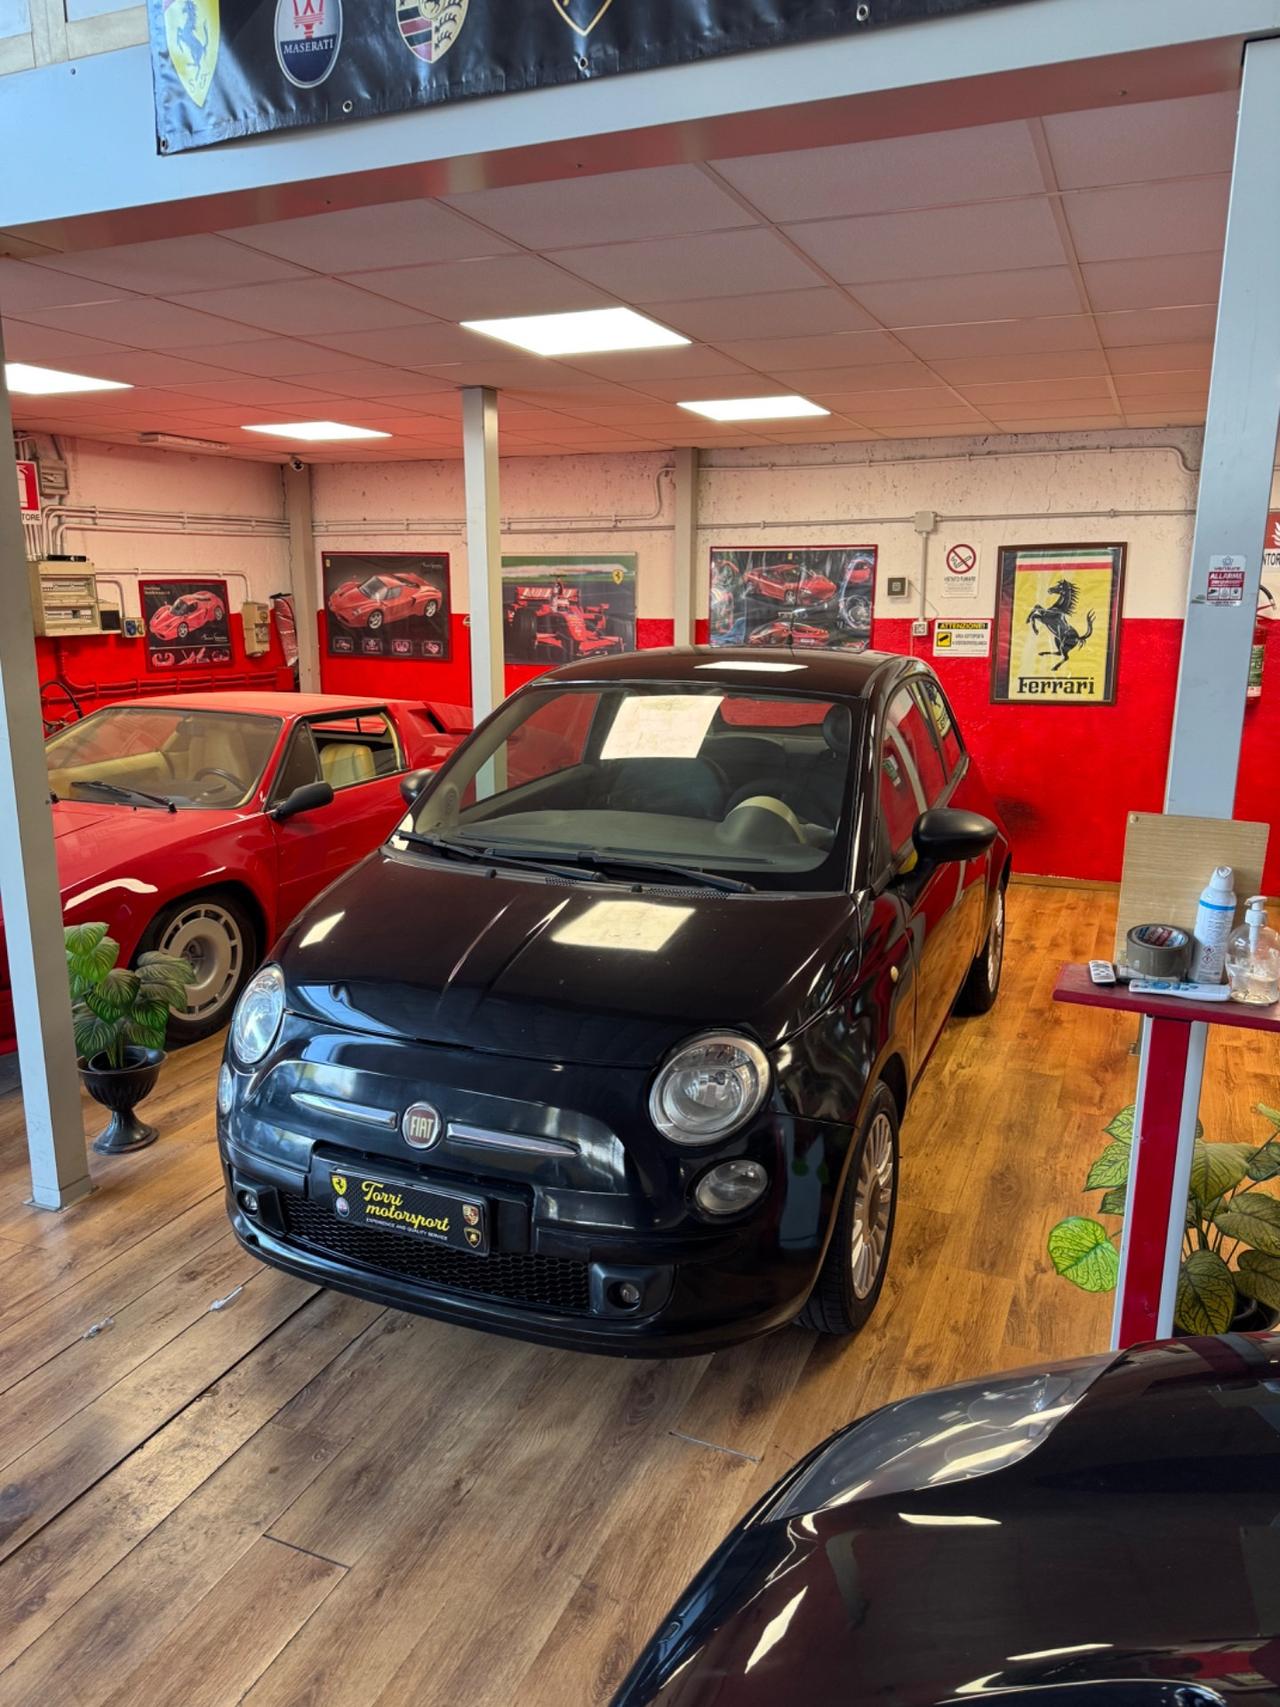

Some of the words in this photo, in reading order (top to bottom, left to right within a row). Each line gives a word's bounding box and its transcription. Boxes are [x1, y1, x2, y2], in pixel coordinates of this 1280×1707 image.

[283, 38, 334, 55] MASERATI
[1017, 676, 1095, 694] Ferrari
[410, 1115, 434, 1139] FIAT
[361, 1180, 404, 1206] Torri
[365, 1205, 450, 1231] motorsport
